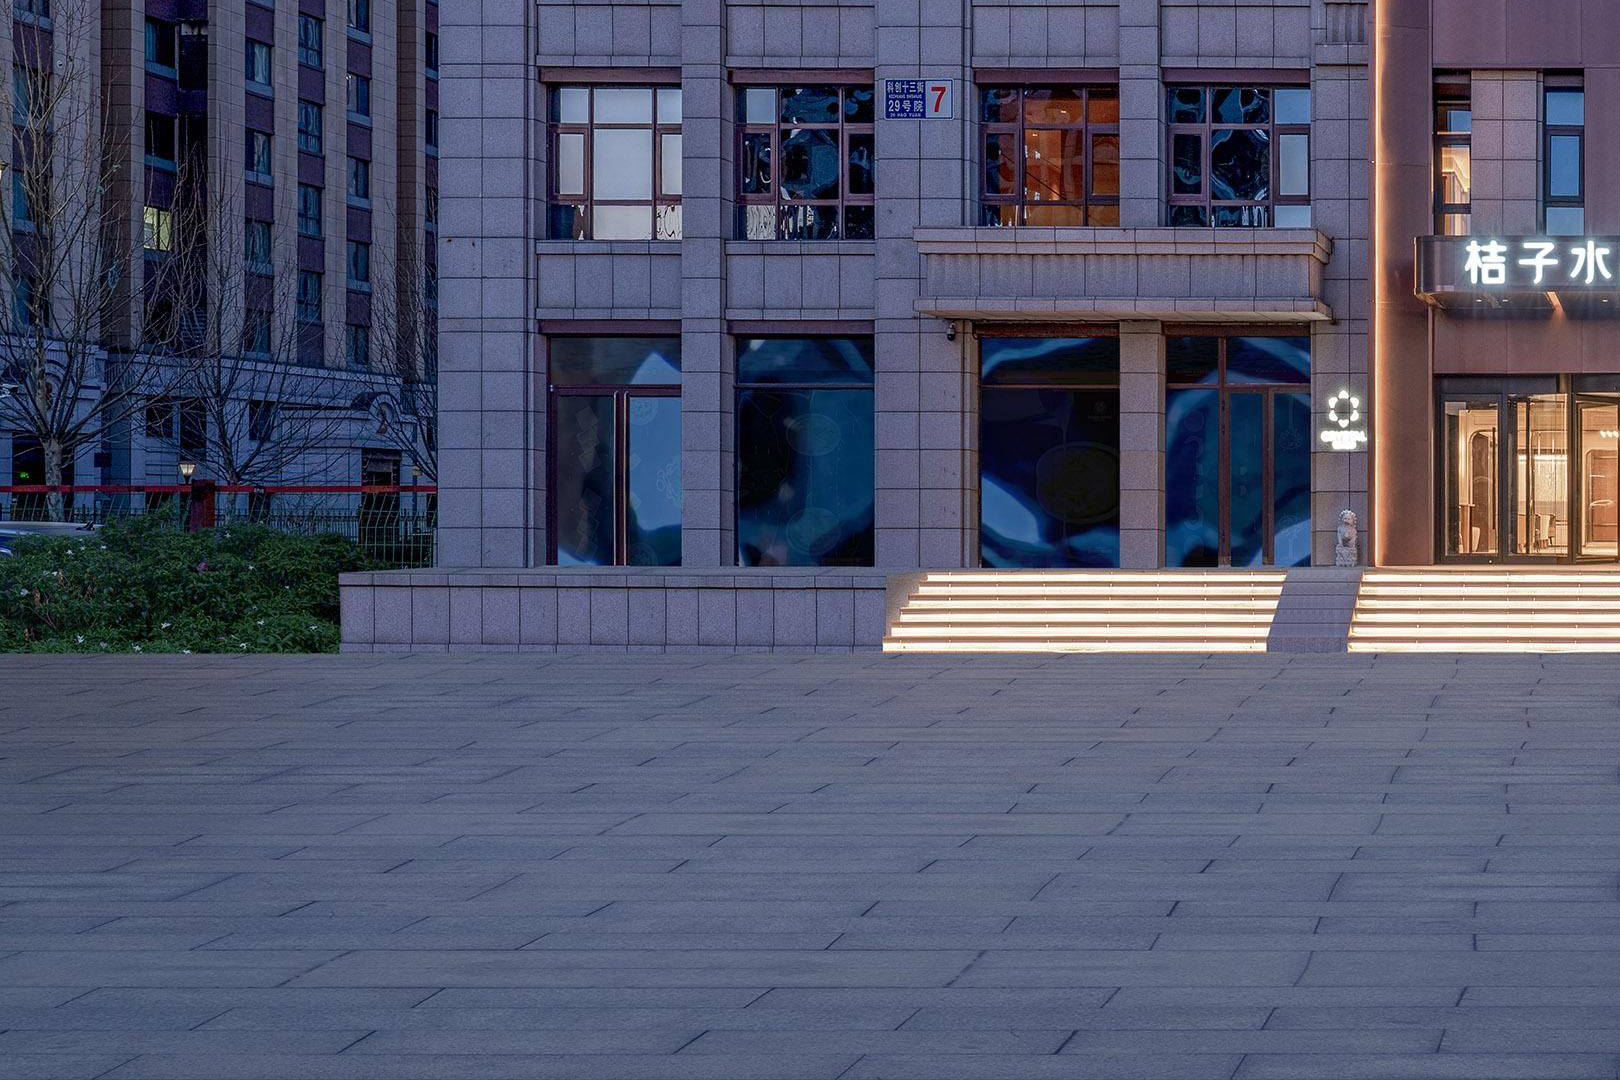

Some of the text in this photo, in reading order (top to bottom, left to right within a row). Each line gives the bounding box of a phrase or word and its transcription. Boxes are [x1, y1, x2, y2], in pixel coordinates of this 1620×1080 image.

[887, 81, 925, 94] 科创十三街
[930, 86, 947, 113] 7
[888, 100, 924, 113] 29号院
